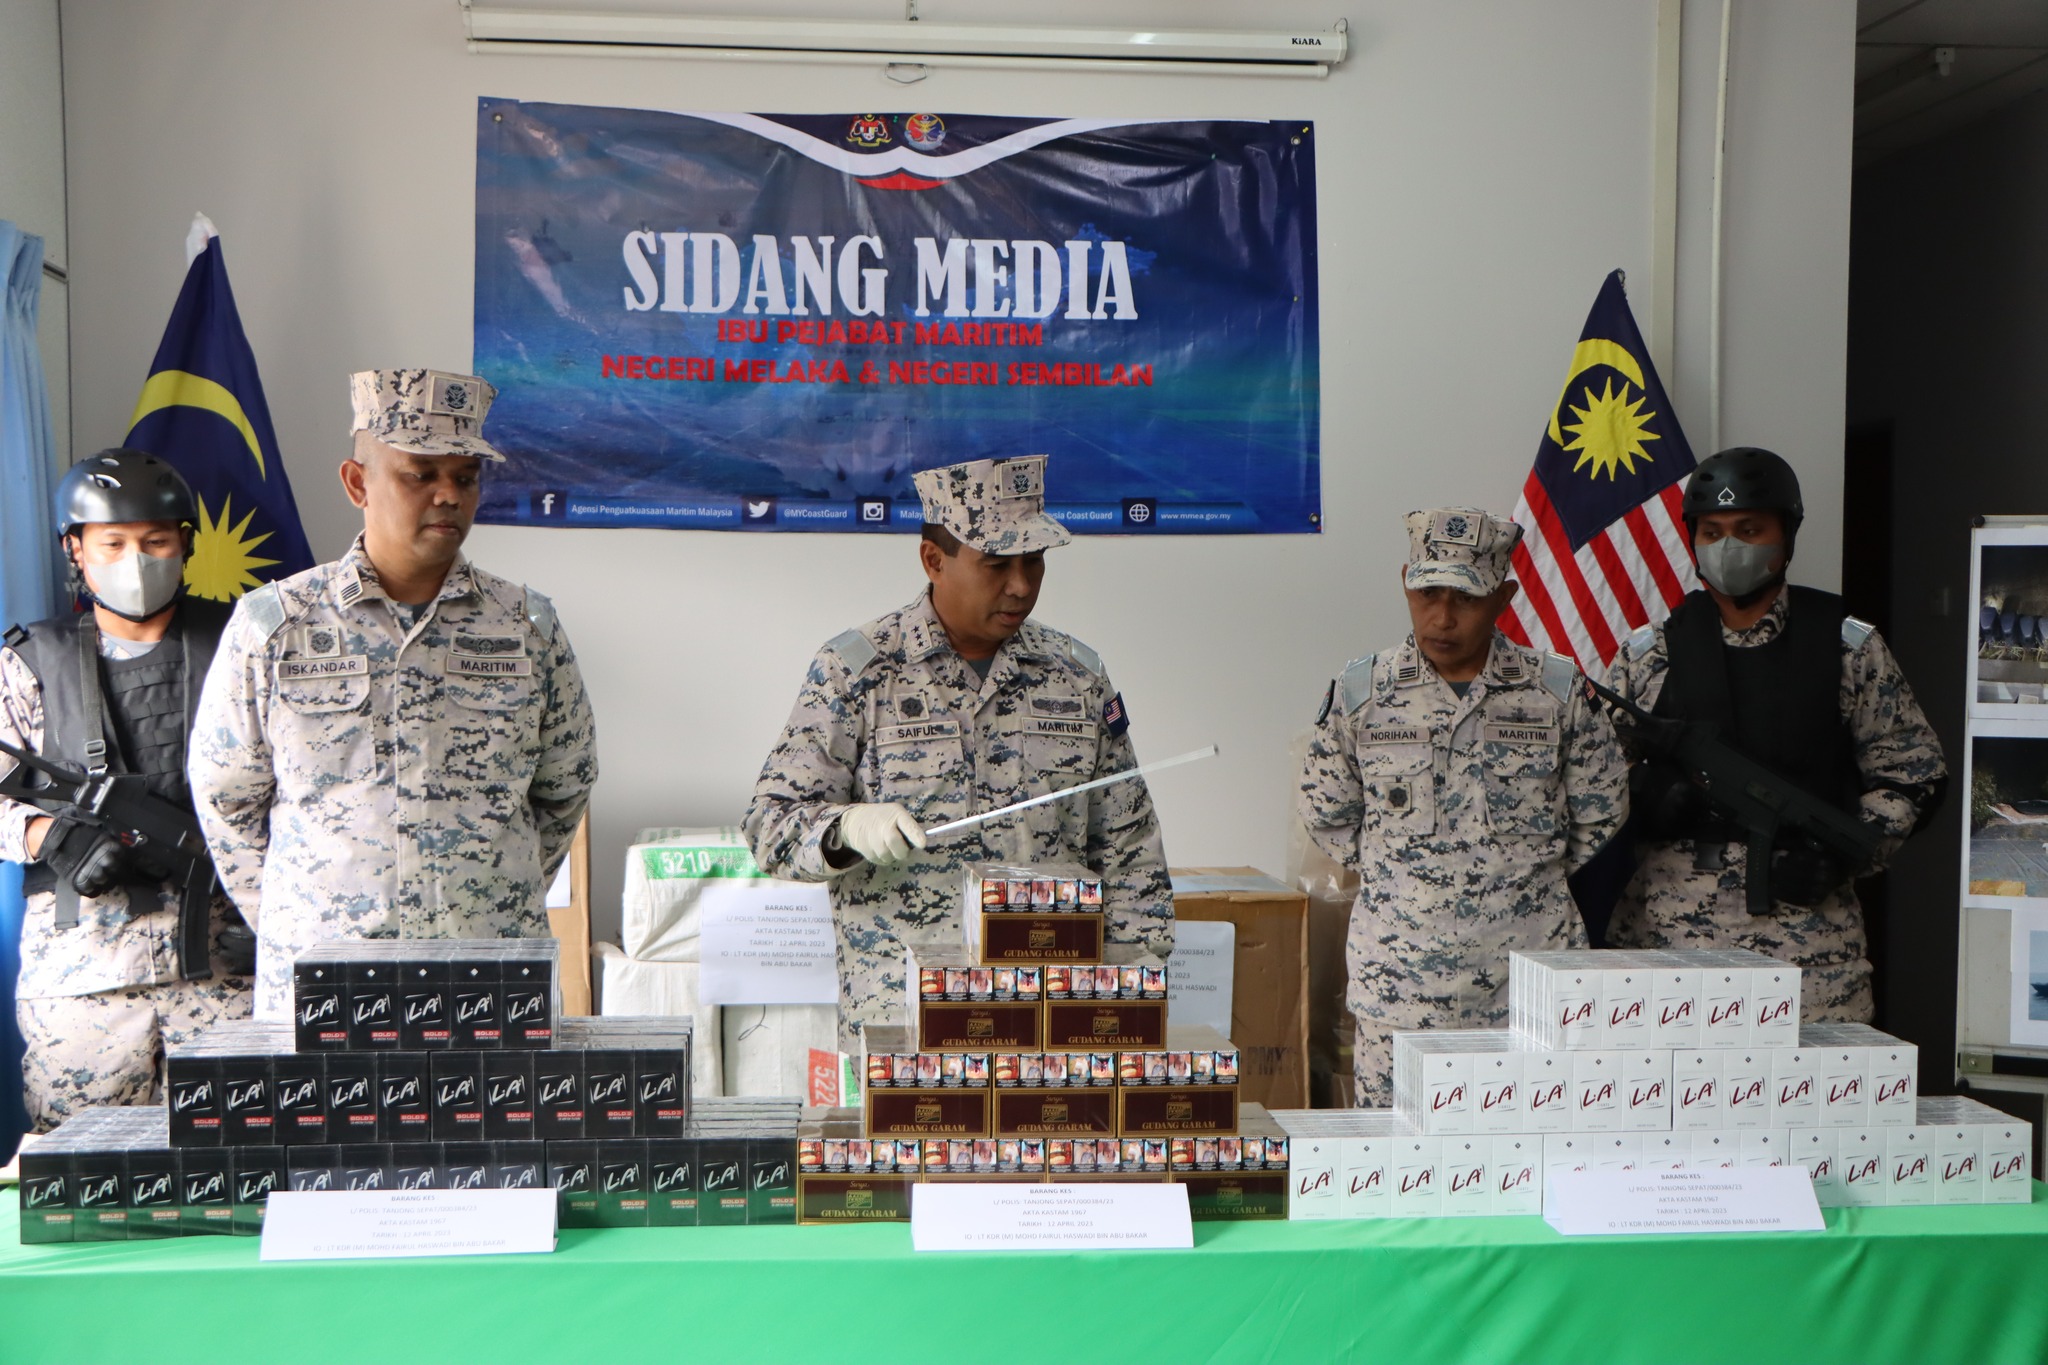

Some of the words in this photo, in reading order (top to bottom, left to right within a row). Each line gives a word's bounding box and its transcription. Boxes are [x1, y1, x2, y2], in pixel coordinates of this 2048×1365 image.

[622, 230, 889, 317] SIDANG
[914, 237, 1138, 320] MEDIA
[717, 319, 769, 343] IBU
[777, 320, 907, 346] PEJABAT
[915, 322, 1043, 346] MARITIM
[600, 355, 715, 382] NEGERI
[724, 359, 850, 384] MELAKA
[859, 360, 880, 384] &
[889, 361, 998, 385] NEGERI
[1006, 362, 1153, 387] SEMBILAN
[572, 504, 598, 514] Agensi
[600, 505, 664, 516] Penguatkuasaan
[666, 507, 696, 516] Maritim
[698, 508, 733, 517] Malaysia
[784, 509, 848, 518] @MYCoastGuard
[1066, 511, 1088, 520] Coast
[1089, 511, 1113, 520] Guard
[287, 661, 356, 675] ISKANDAR
[460, 660, 516, 672] MARITIM
[898, 727, 938, 738] SAIFUL
[1038, 721, 1084, 734] MARITIM
[1371, 730, 1417, 741] NORIHAN
[1499, 729, 1547, 741] MARITIM
[662, 850, 711, 874] 5210
[1182, 1121, 1216, 1129] GARAM
[862, 1209, 897, 1217] GARAM
[1232, 1206, 1266, 1214] GARAM
